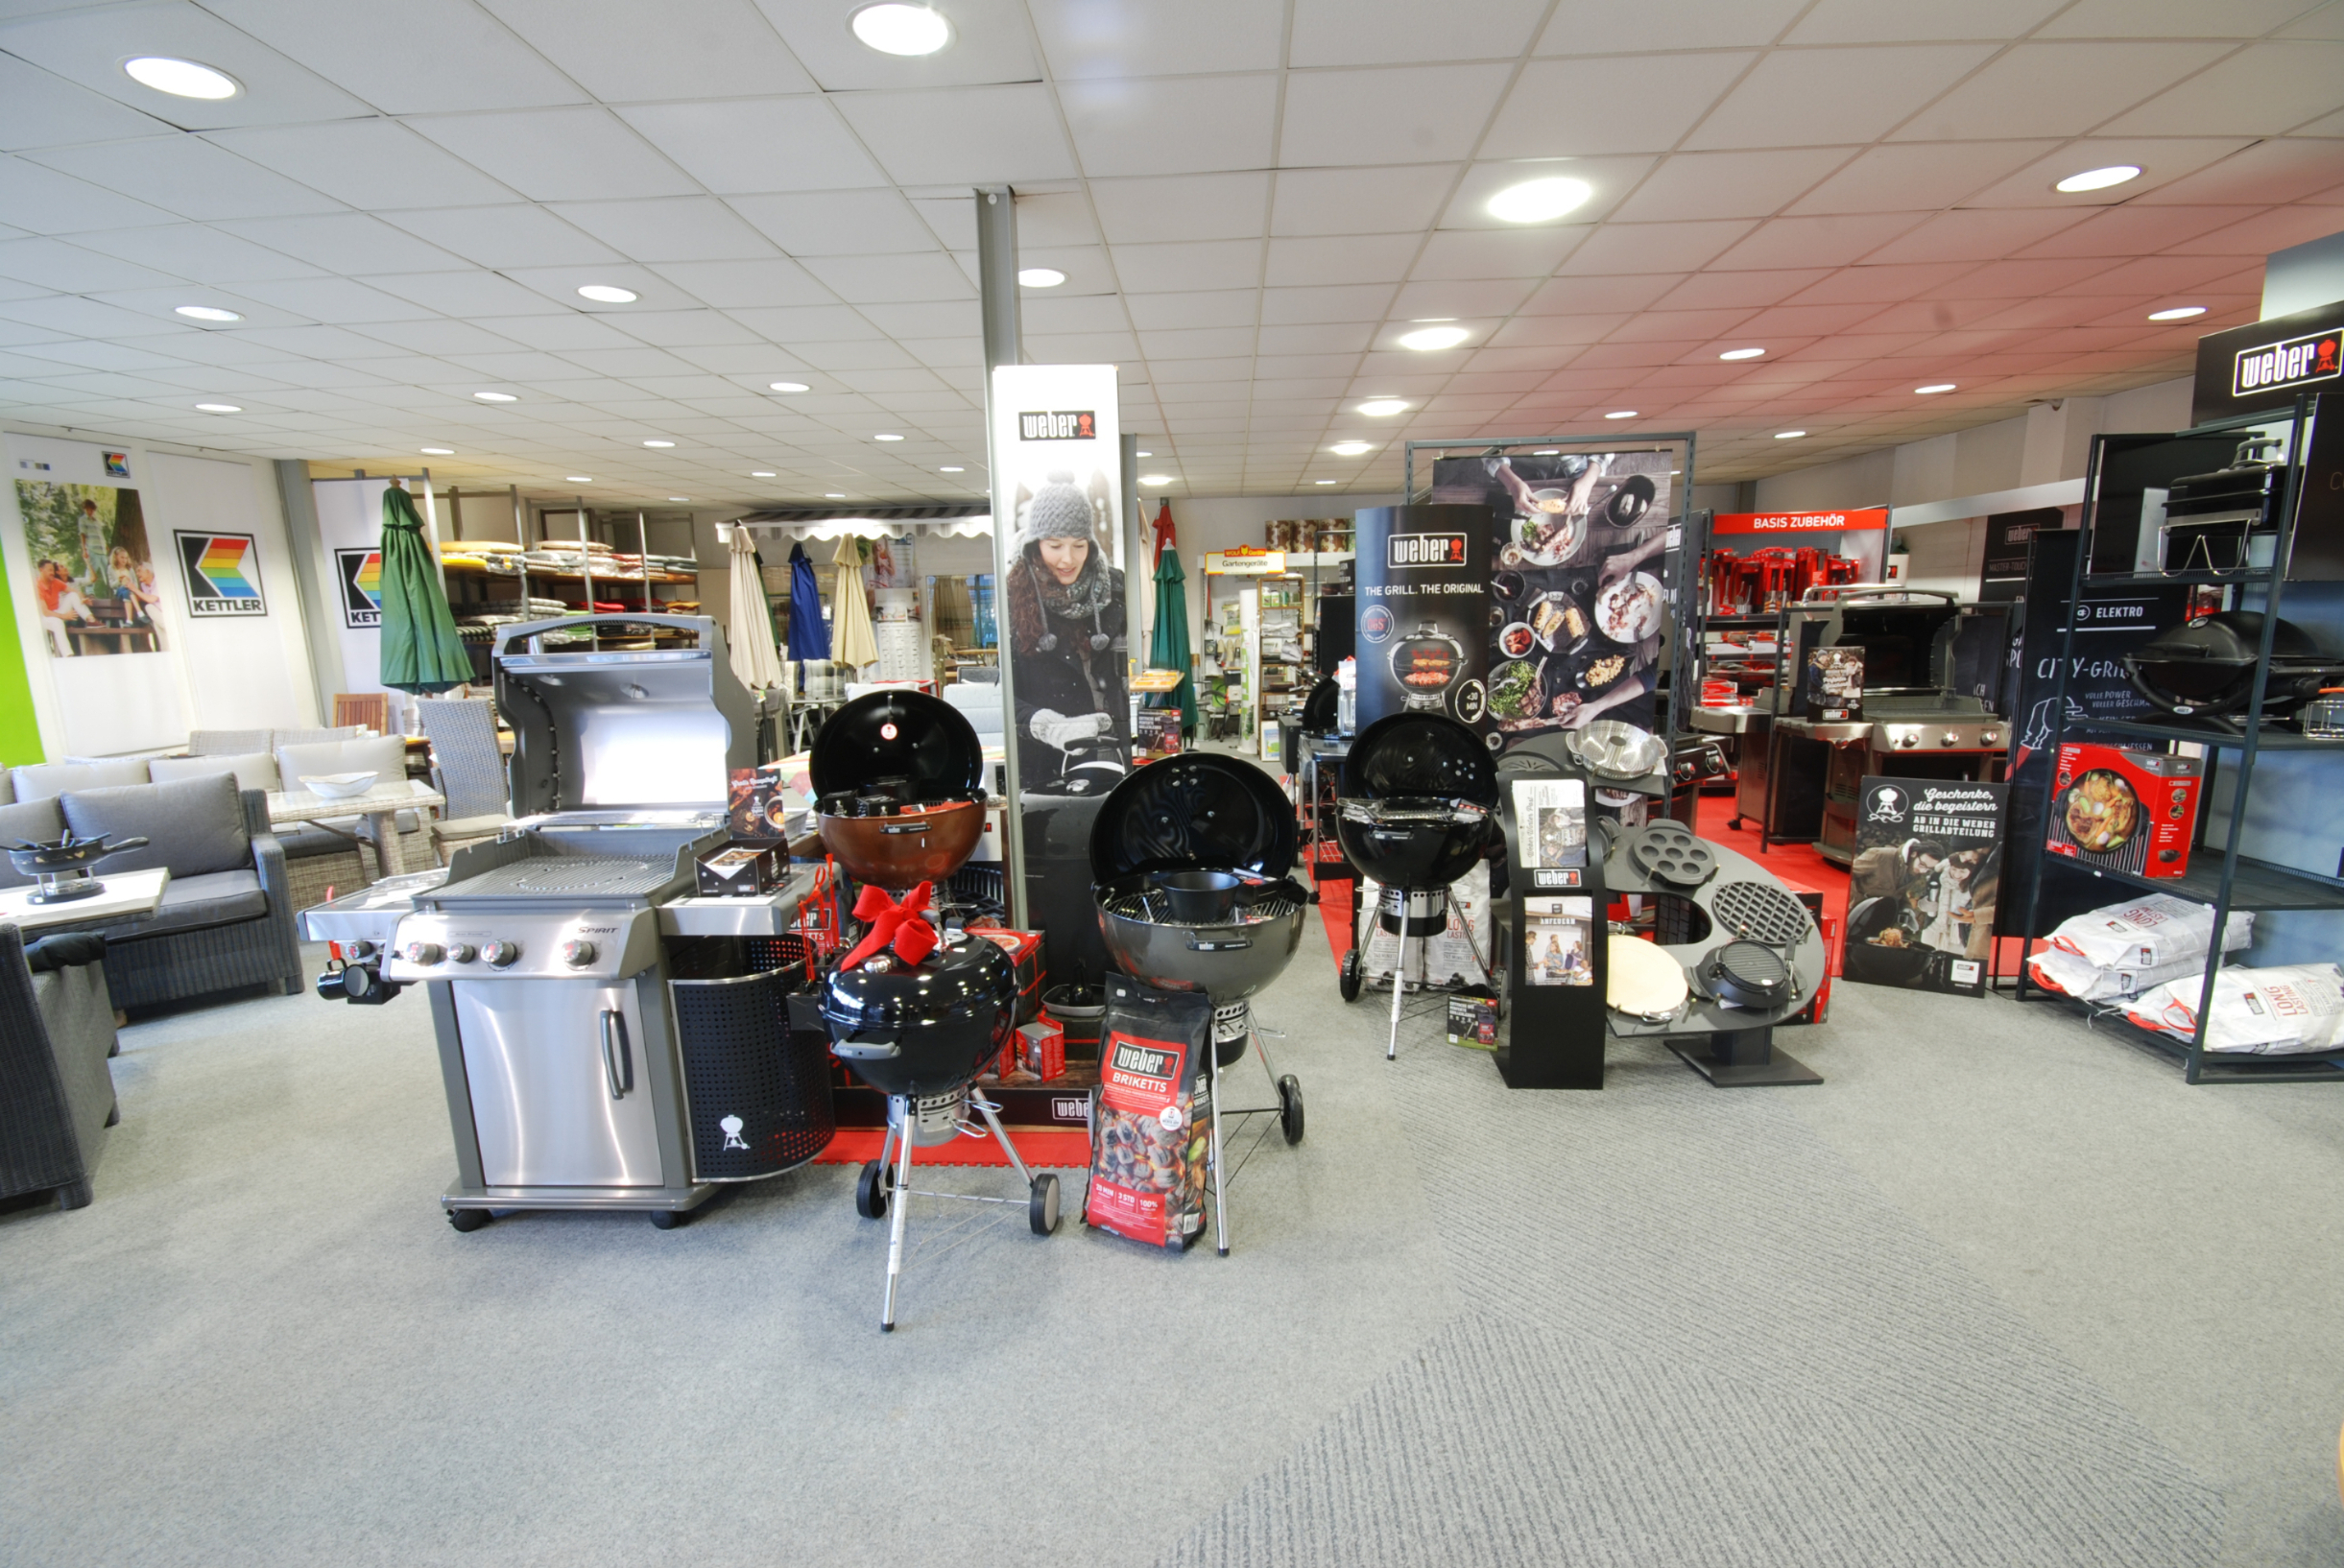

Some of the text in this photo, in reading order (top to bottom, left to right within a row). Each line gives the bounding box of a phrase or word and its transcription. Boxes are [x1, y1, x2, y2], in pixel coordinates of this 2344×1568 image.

[2241, 343, 2315, 388] weber
[1022, 413, 1077, 439] weber
[1754, 513, 1845, 529] BASIS ZUBEHÖR
[2008, 527, 2029, 542] weber
[1394, 535, 1448, 563] weber
[1365, 583, 1484, 596] THE GRILL. THE ORIGINAL
[193, 599, 262, 611] KETTLER
[2096, 606, 2143, 618] ELEKTRO
[351, 612, 380, 623] KET
[2105, 691, 2131, 700] POWER
[1924, 788, 1994, 802] Geschenke,
[1913, 801, 1997, 814] die begeistern
[1913, 816, 1996, 829] AB IN DIE WEBER
[1912, 824, 1995, 838] GRILLABTEILUNG
[1538, 870, 1569, 885] weber
[2263, 986, 2298, 1015] LONG
[2280, 985, 2308, 1015] LASTING
[1117, 1047, 1164, 1073] weber
[1112, 1072, 1167, 1093] BRIKETTS
[1103, 1186, 1113, 1197] MIN
[1123, 1195, 1136, 1203] STD
[1139, 1199, 1158, 1208] 100%
